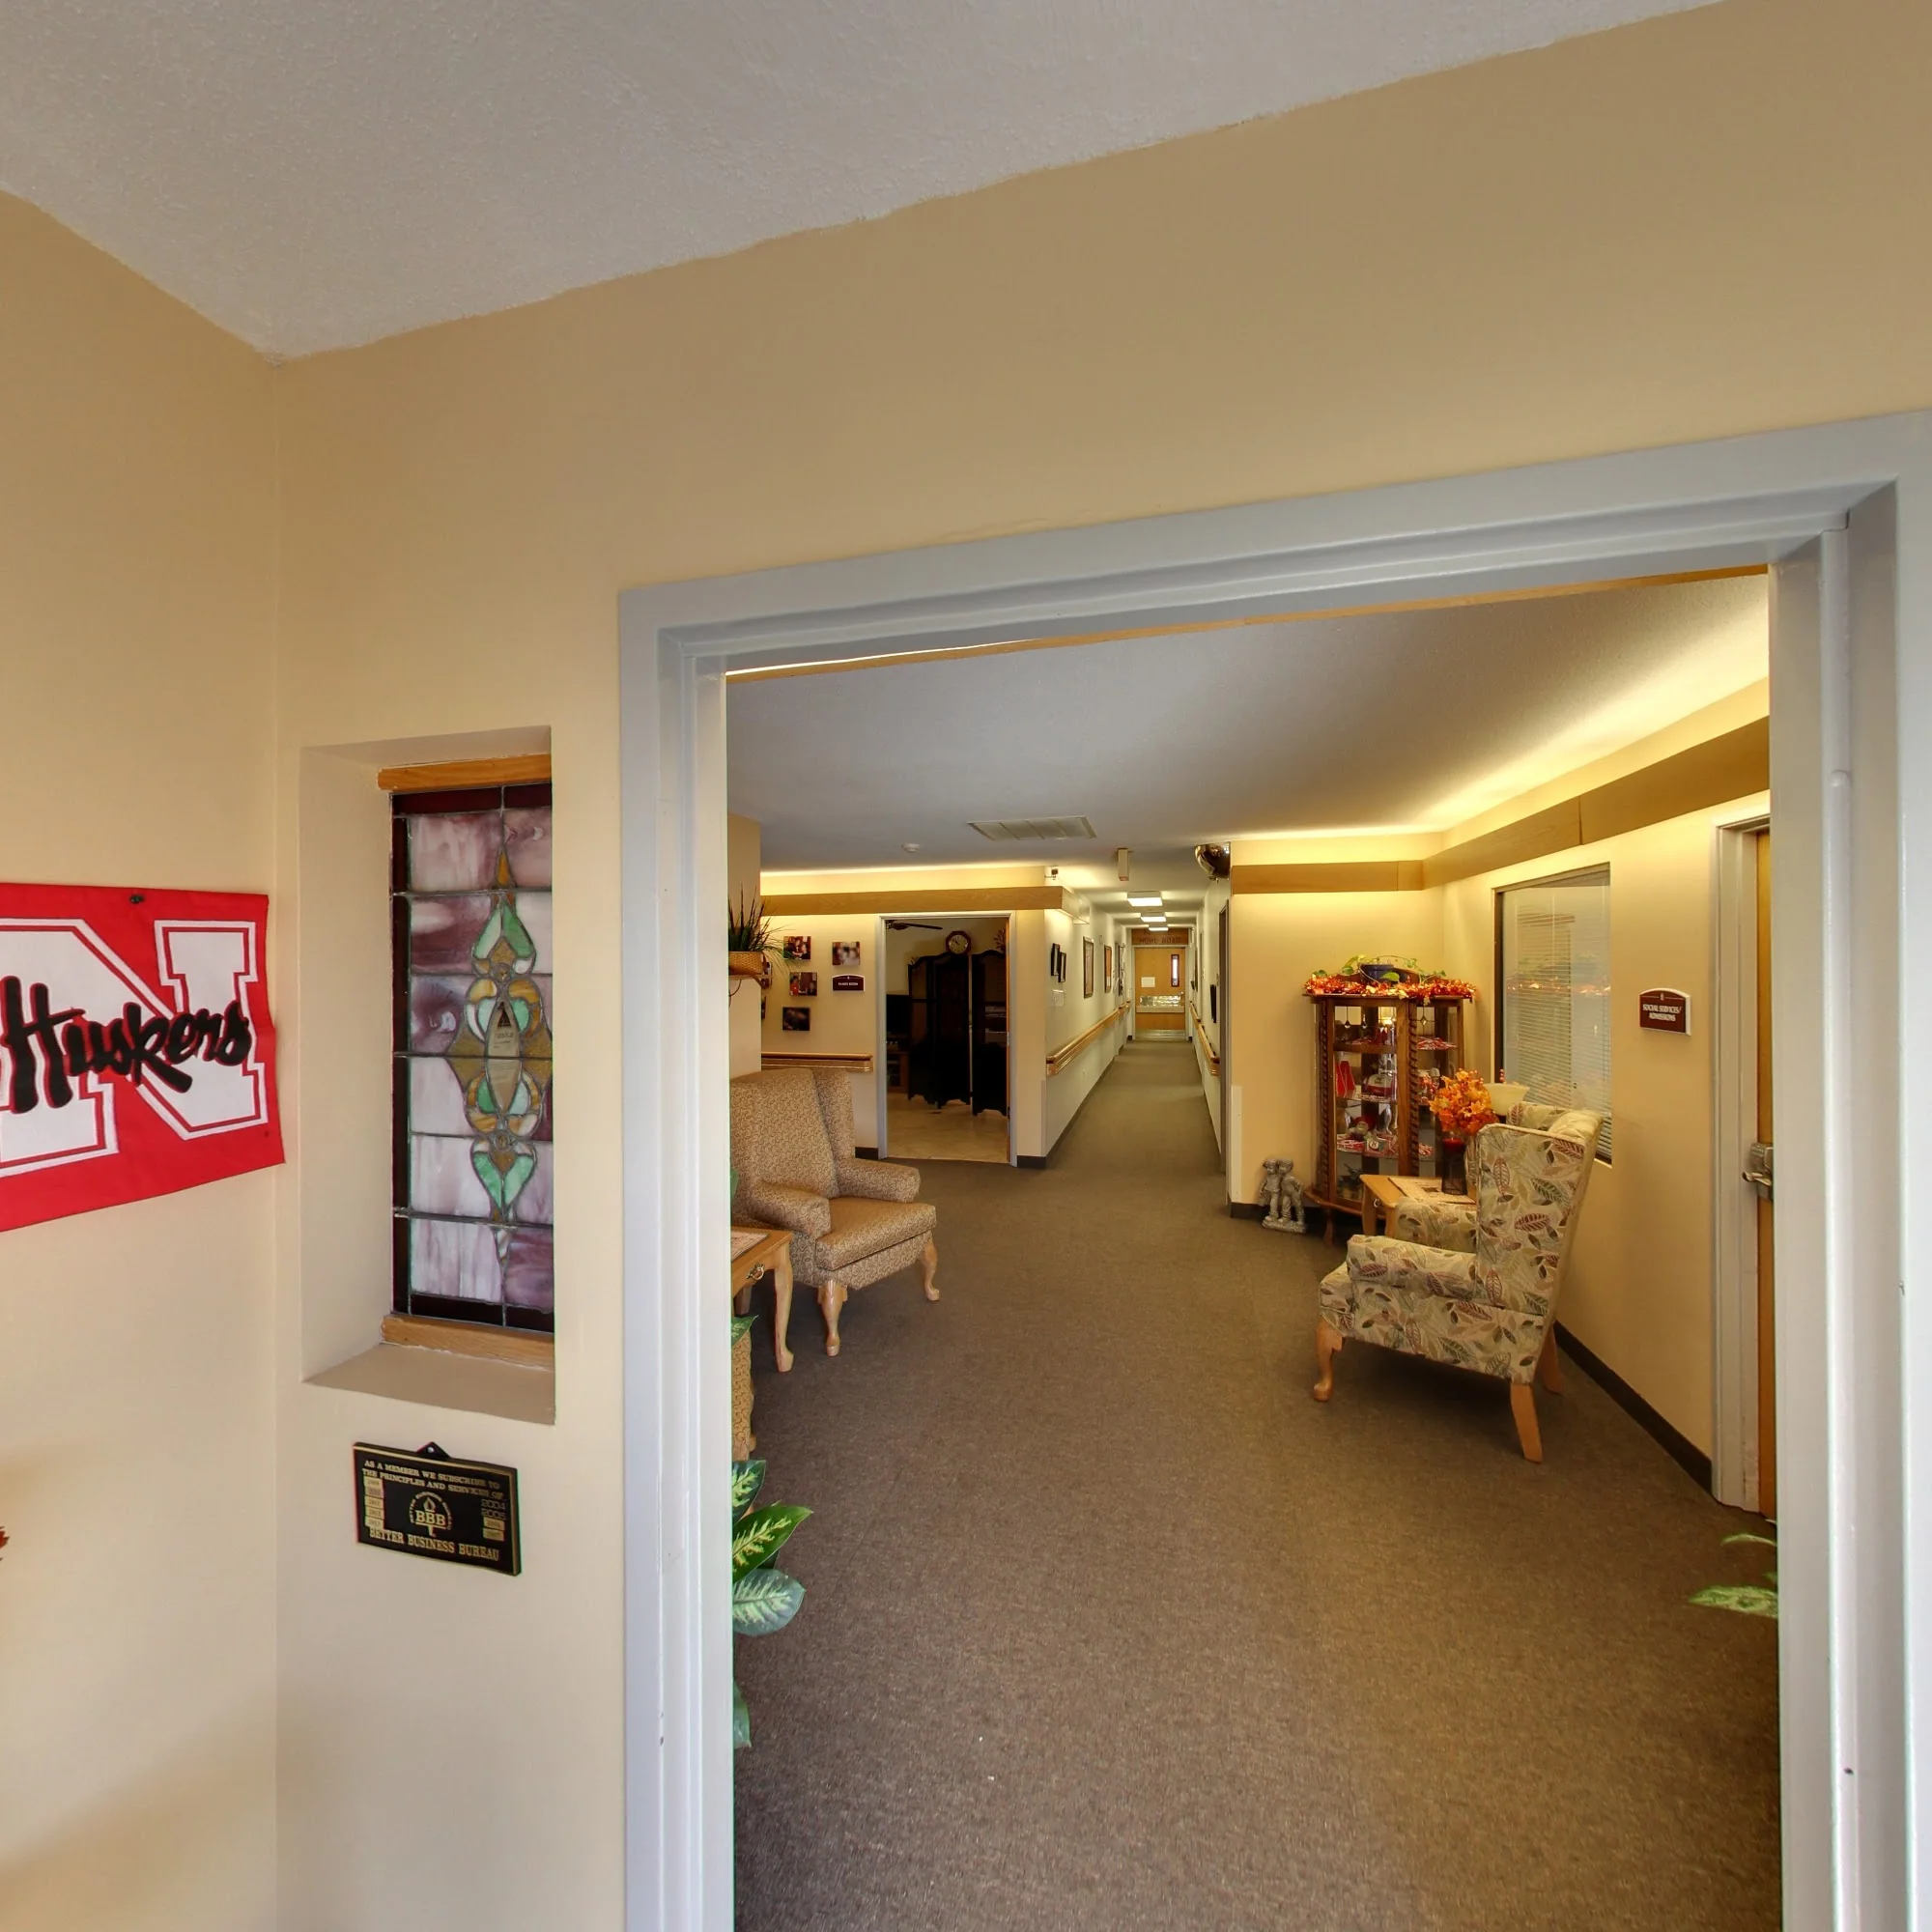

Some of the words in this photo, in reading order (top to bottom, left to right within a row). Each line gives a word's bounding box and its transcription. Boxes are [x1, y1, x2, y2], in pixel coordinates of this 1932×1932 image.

[1, 975, 253, 1115] Huskers
[362, 1468, 378, 1479] THE
[380, 1471, 426, 1488] PRINCIPLES
[427, 1481, 445, 1491] AND
[491, 1491, 504, 1500] OF
[363, 1460, 375, 1468] AS
[384, 1463, 421, 1477] MEMBER
[421, 1470, 436, 1480] WE
[438, 1473, 487, 1488] SUBSCRIBE
[488, 1480, 500, 1490] TO
[414, 1509, 446, 1526] BBB
[369, 1526, 404, 1545] BETTER
[407, 1534, 455, 1554] BUSINESS
[459, 1543, 500, 1562] BUREAU
